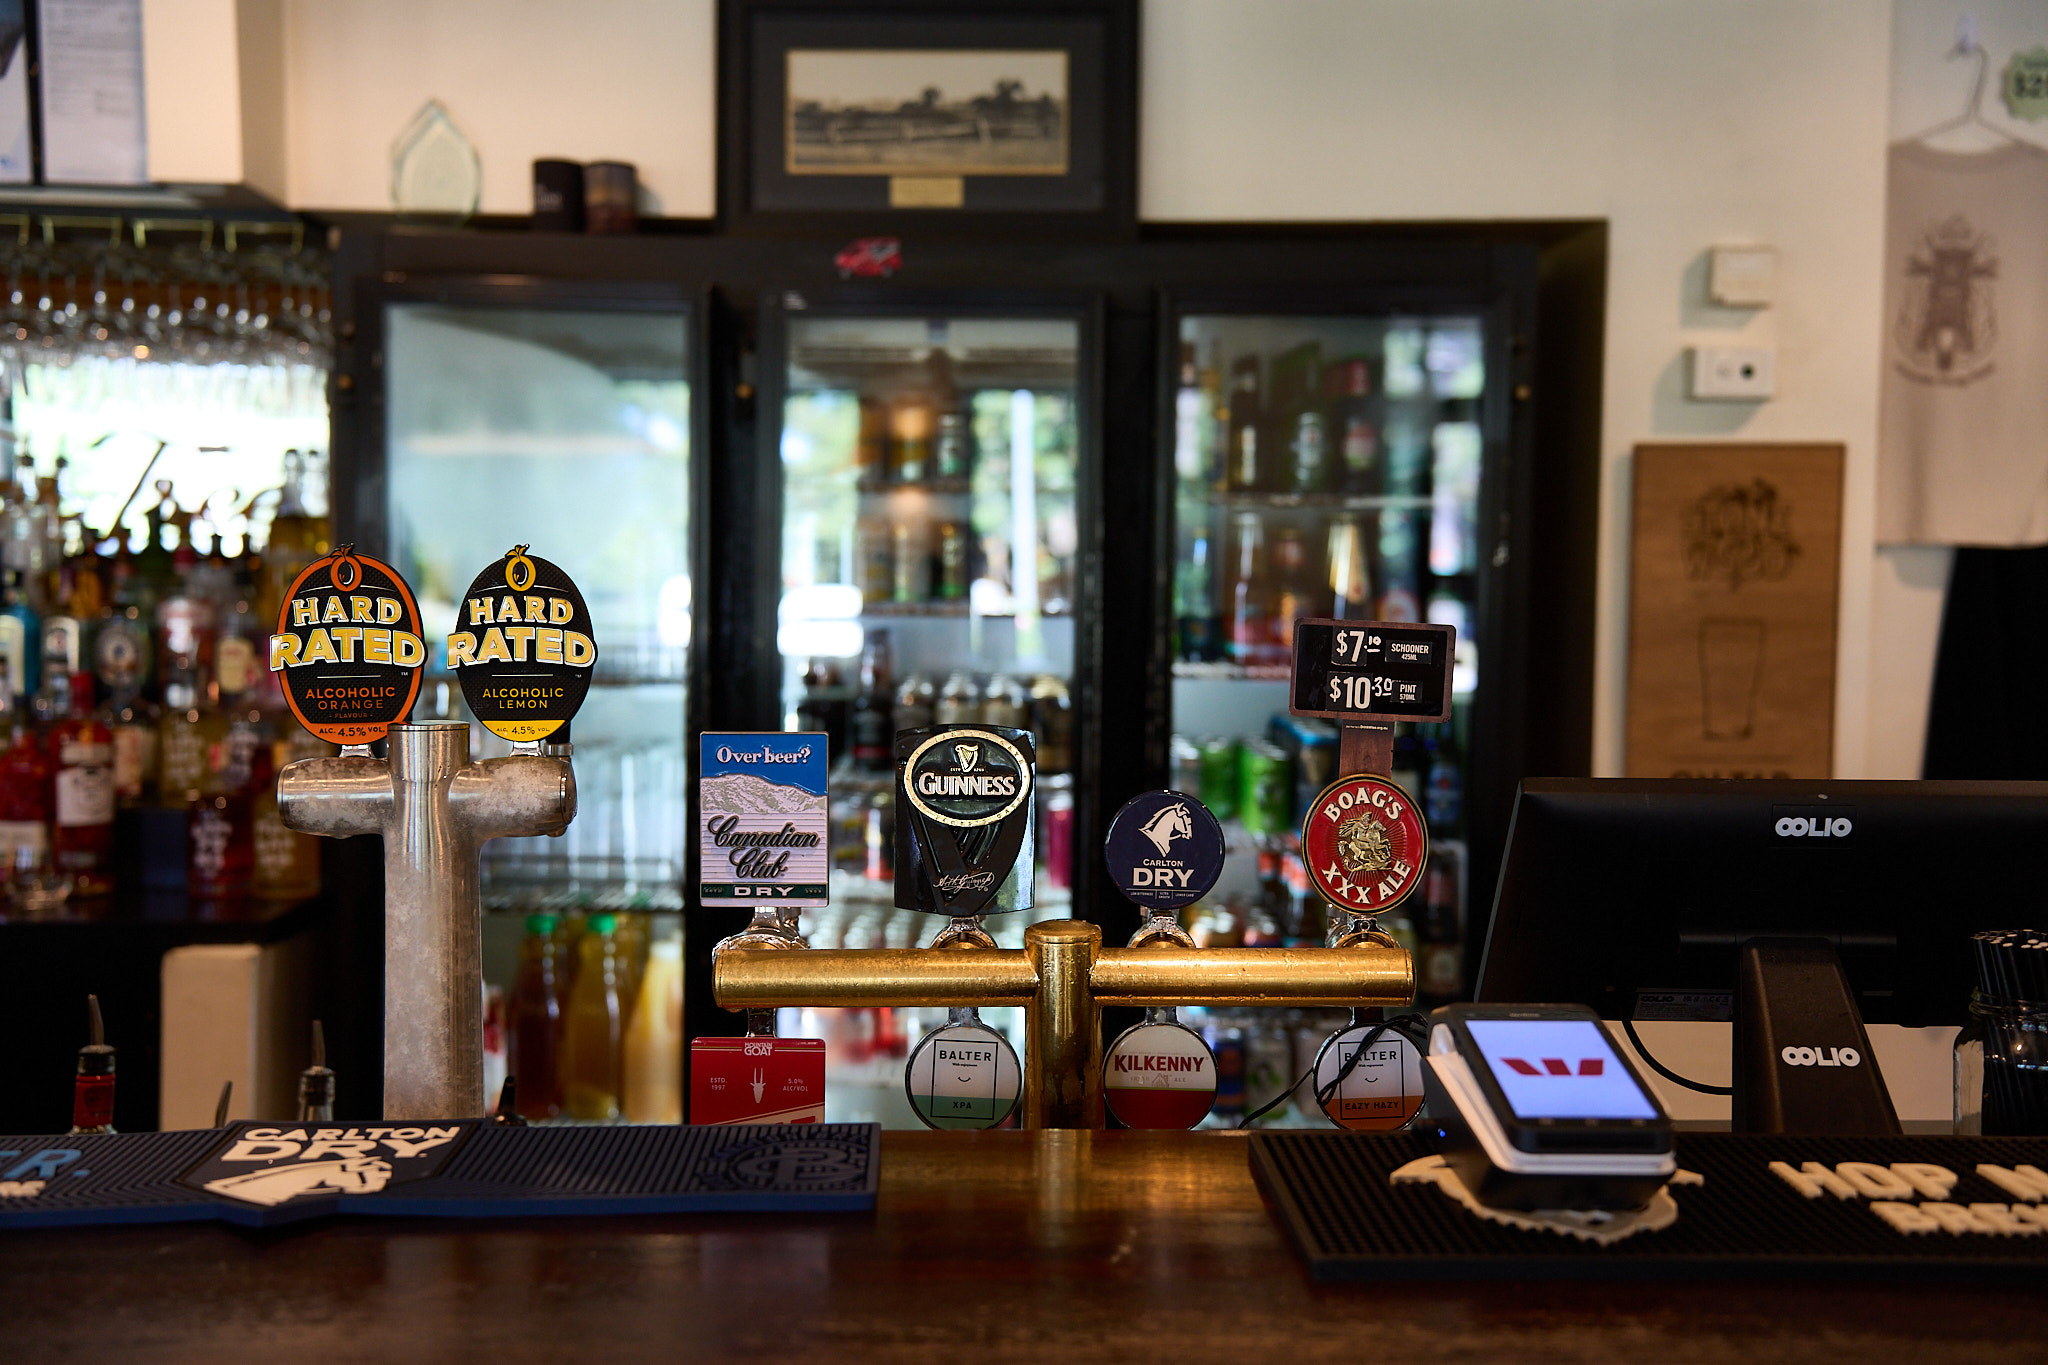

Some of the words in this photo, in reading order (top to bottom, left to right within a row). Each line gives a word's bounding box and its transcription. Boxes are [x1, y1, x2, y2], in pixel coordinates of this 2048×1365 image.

[292, 596, 402, 626] HARD
[468, 595, 573, 625] HARD
[269, 627, 425, 672] RATED
[447, 626, 596, 669] RATED
[1391, 643, 1429, 654] SCHOONER
[305, 687, 396, 699] ALCOHOLIC
[482, 688, 564, 698] ALCOHOLIC
[1400, 684, 1416, 693] PINT
[318, 699, 384, 710] ORANGE
[499, 700, 548, 709] LEMON
[338, 727, 366, 737] 4.5%
[512, 727, 536, 735] 4.5%
[716, 746, 762, 763] Over
[763, 746, 811, 763] beer?
[918, 772, 1015, 796] GUINNESS
[1323, 787, 1403, 823] BOAG'S
[707, 814, 820, 847] Canadian
[1775, 817, 1852, 837] OOLIO
[728, 847, 790, 878] Club
[1143, 858, 1183, 867] CARLTON
[1133, 867, 1194, 887] DRY
[1377, 860, 1411, 901] ALE
[734, 886, 794, 896] DRY
[744, 1047, 772, 1056] GOAT
[939, 1050, 991, 1061] BALTER
[1345, 1051, 1397, 1061] BLTER
[1782, 1046, 1860, 1067] OOLIO
[1115, 1055, 1204, 1072] KILKENNY
[1345, 1102, 1370, 1110] EAZY
[1374, 1101, 1399, 1109] HAZY
[245, 1126, 460, 1141] CARLTON
[1768, 1161, 1958, 1200] HOP
